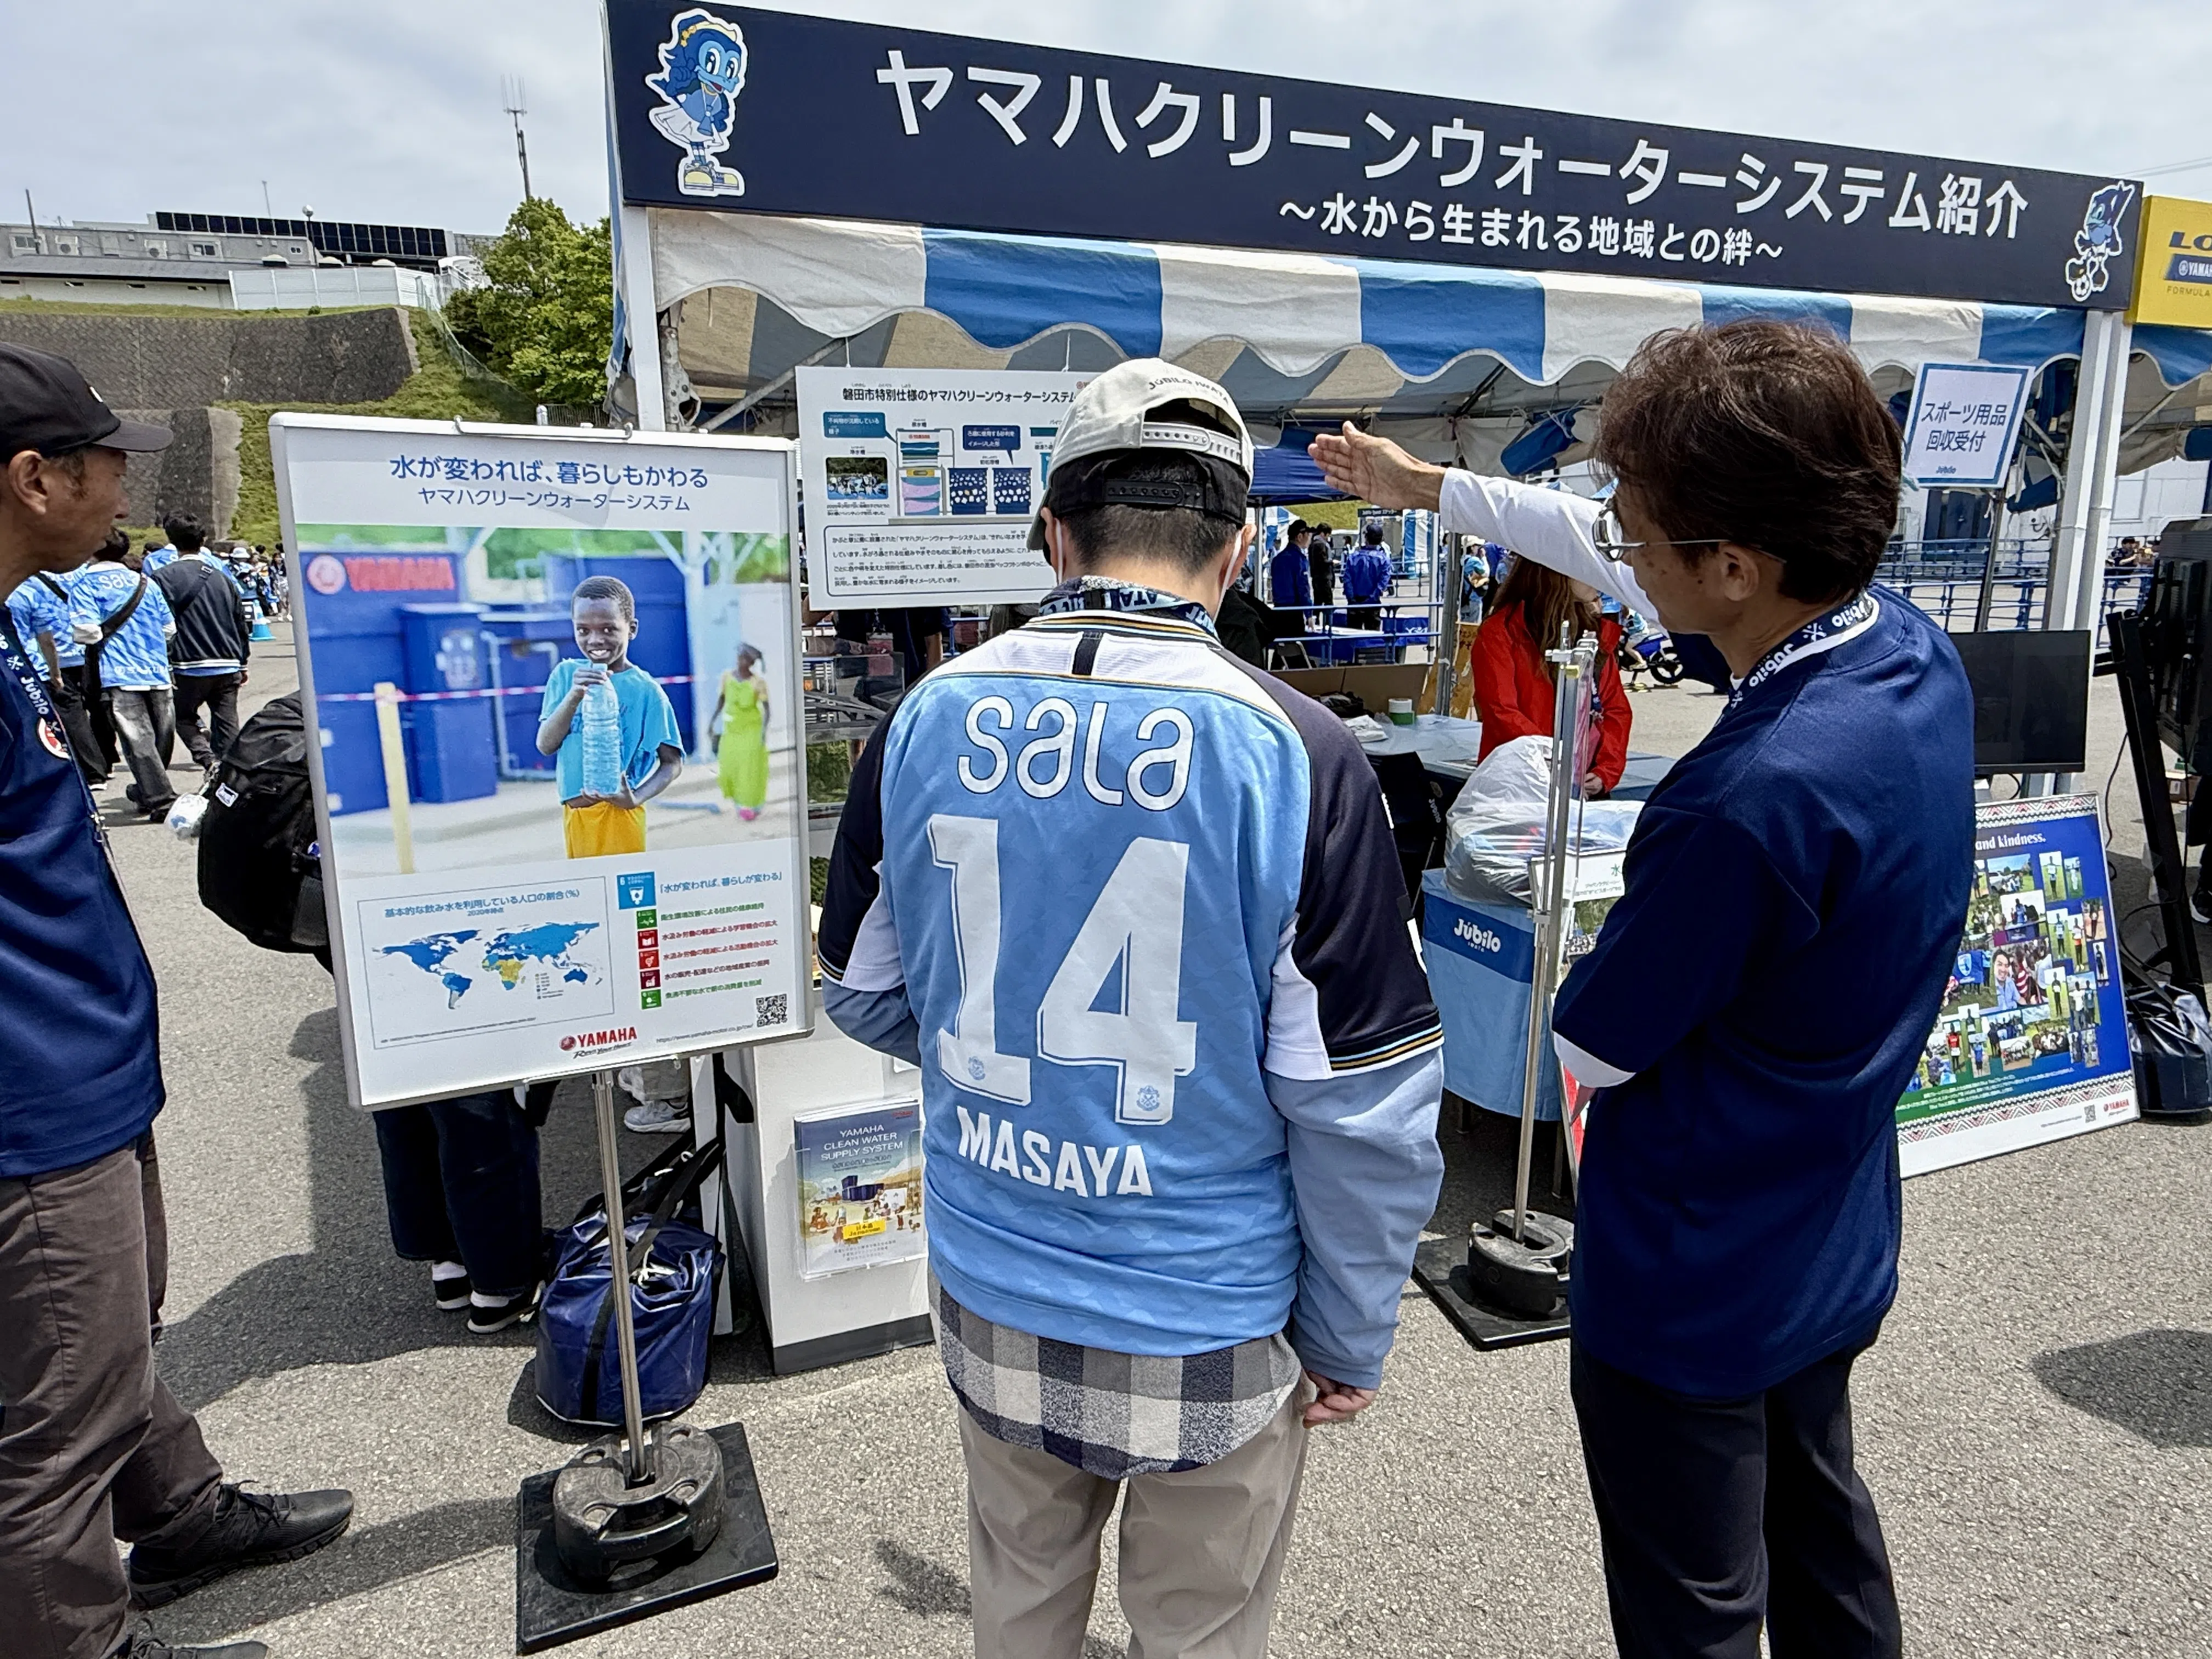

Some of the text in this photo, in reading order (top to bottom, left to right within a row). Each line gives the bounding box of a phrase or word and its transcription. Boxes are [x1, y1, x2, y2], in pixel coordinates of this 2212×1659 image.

[877, 49, 2029, 240] ヤマハクリーンウォーターシステム紹介
[2167, 285, 2210, 297] FORMULA
[1921, 400, 2007, 426] スポーツ用品
[1926, 429, 1987, 452] 回収受付
[390, 454, 708, 489] 水が変われば、暮らしもかわる
[418, 487, 691, 512] ヤマハクリーンウォーターシステム
[956, 695, 1194, 811] sala
[1997, 833, 2046, 848] kindness.
[1454, 918, 1501, 953] Júbilo
[927, 812, 1198, 1126] 14
[577, 1026, 637, 1048] YAMAHA
[823, 1131, 898, 1151] CLEAN WATER
[839, 1124, 884, 1138] YAMAHA
[821, 1141, 904, 1161] SUPPLY SYSTEM
[956, 1105, 1154, 1198] MASAYA
